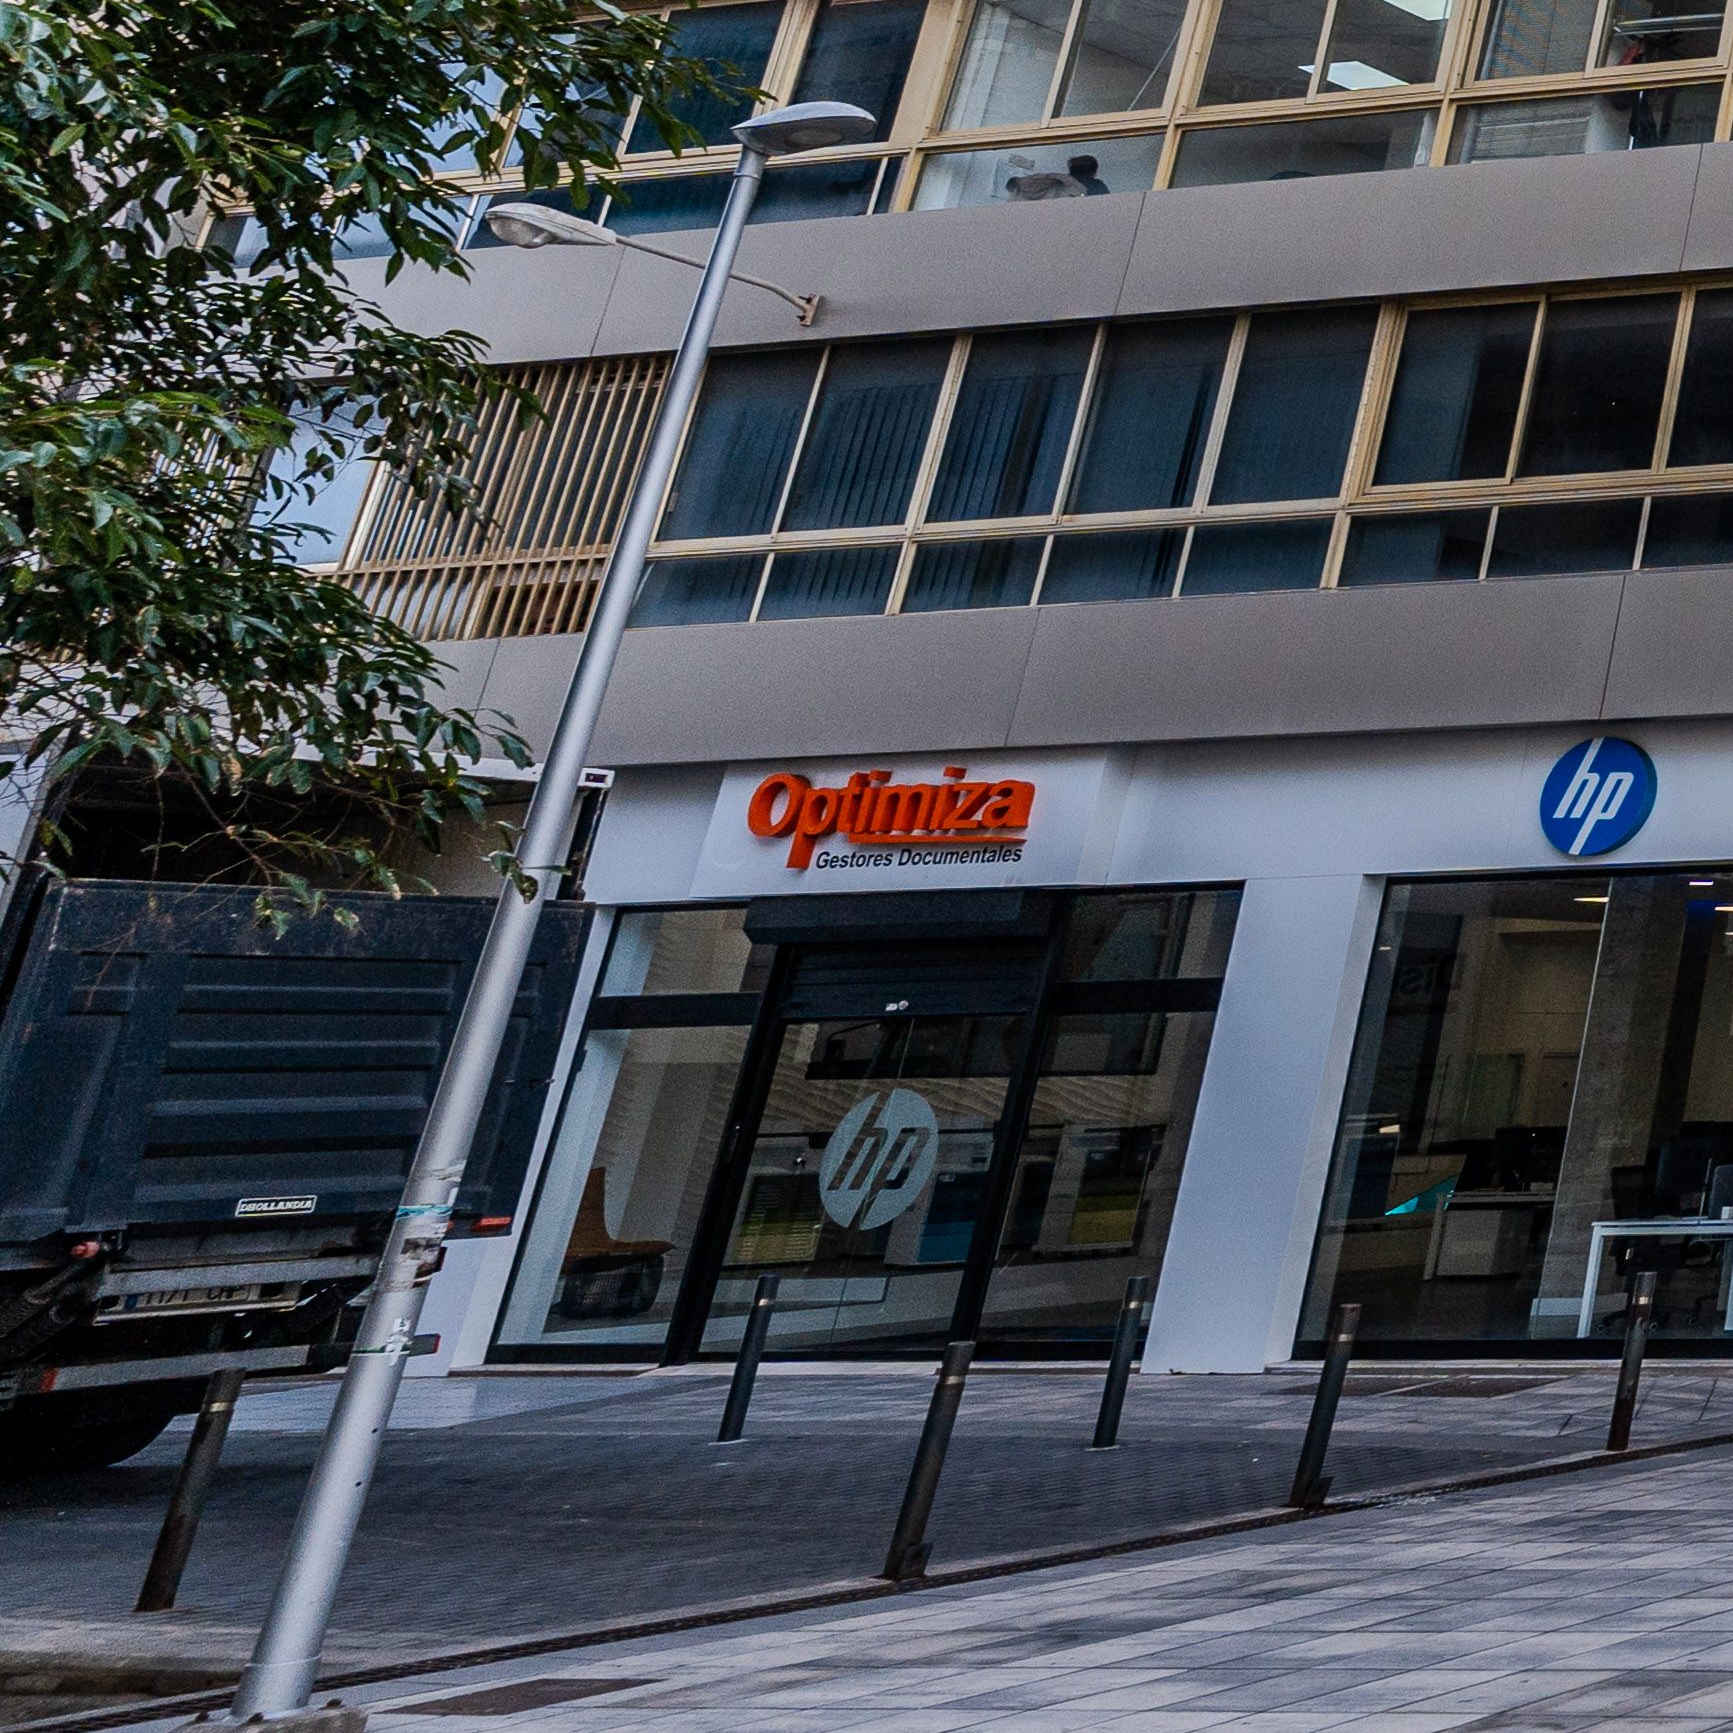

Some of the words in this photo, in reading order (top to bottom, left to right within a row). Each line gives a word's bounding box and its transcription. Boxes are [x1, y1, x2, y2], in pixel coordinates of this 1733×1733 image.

[747, 766, 1036, 870] Optimiza
[1553, 736, 1635, 856] hp
[816, 851, 893, 869] Gestores
[898, 846, 1023, 867] Documentales
[826, 1088, 930, 1229] hp
